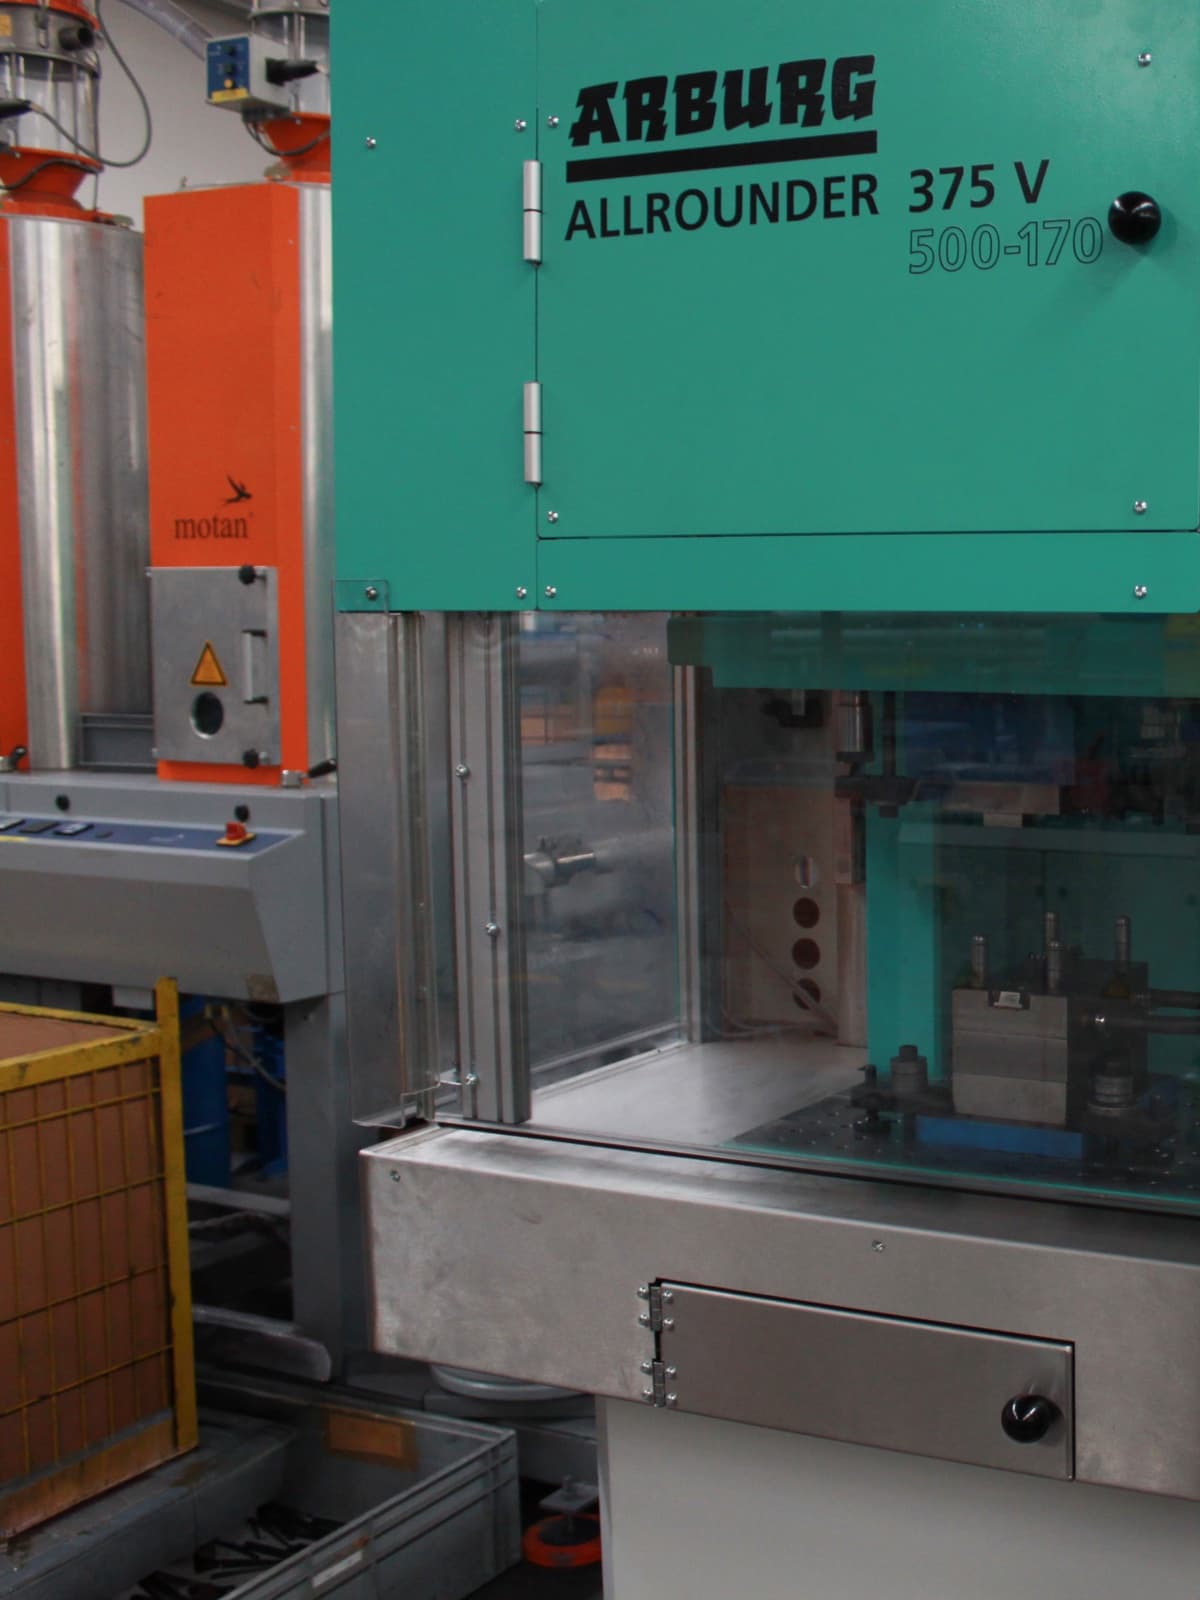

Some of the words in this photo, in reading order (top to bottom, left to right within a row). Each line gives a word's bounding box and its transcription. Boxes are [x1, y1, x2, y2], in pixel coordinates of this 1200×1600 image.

[567, 54, 877, 148] ARBURG
[564, 173, 880, 242] ALLROUNDER
[908, 163, 995, 214] 375
[1013, 159, 1050, 204] V
[908, 216, 1104, 275] 500-170
[175, 516, 249, 539] motan
